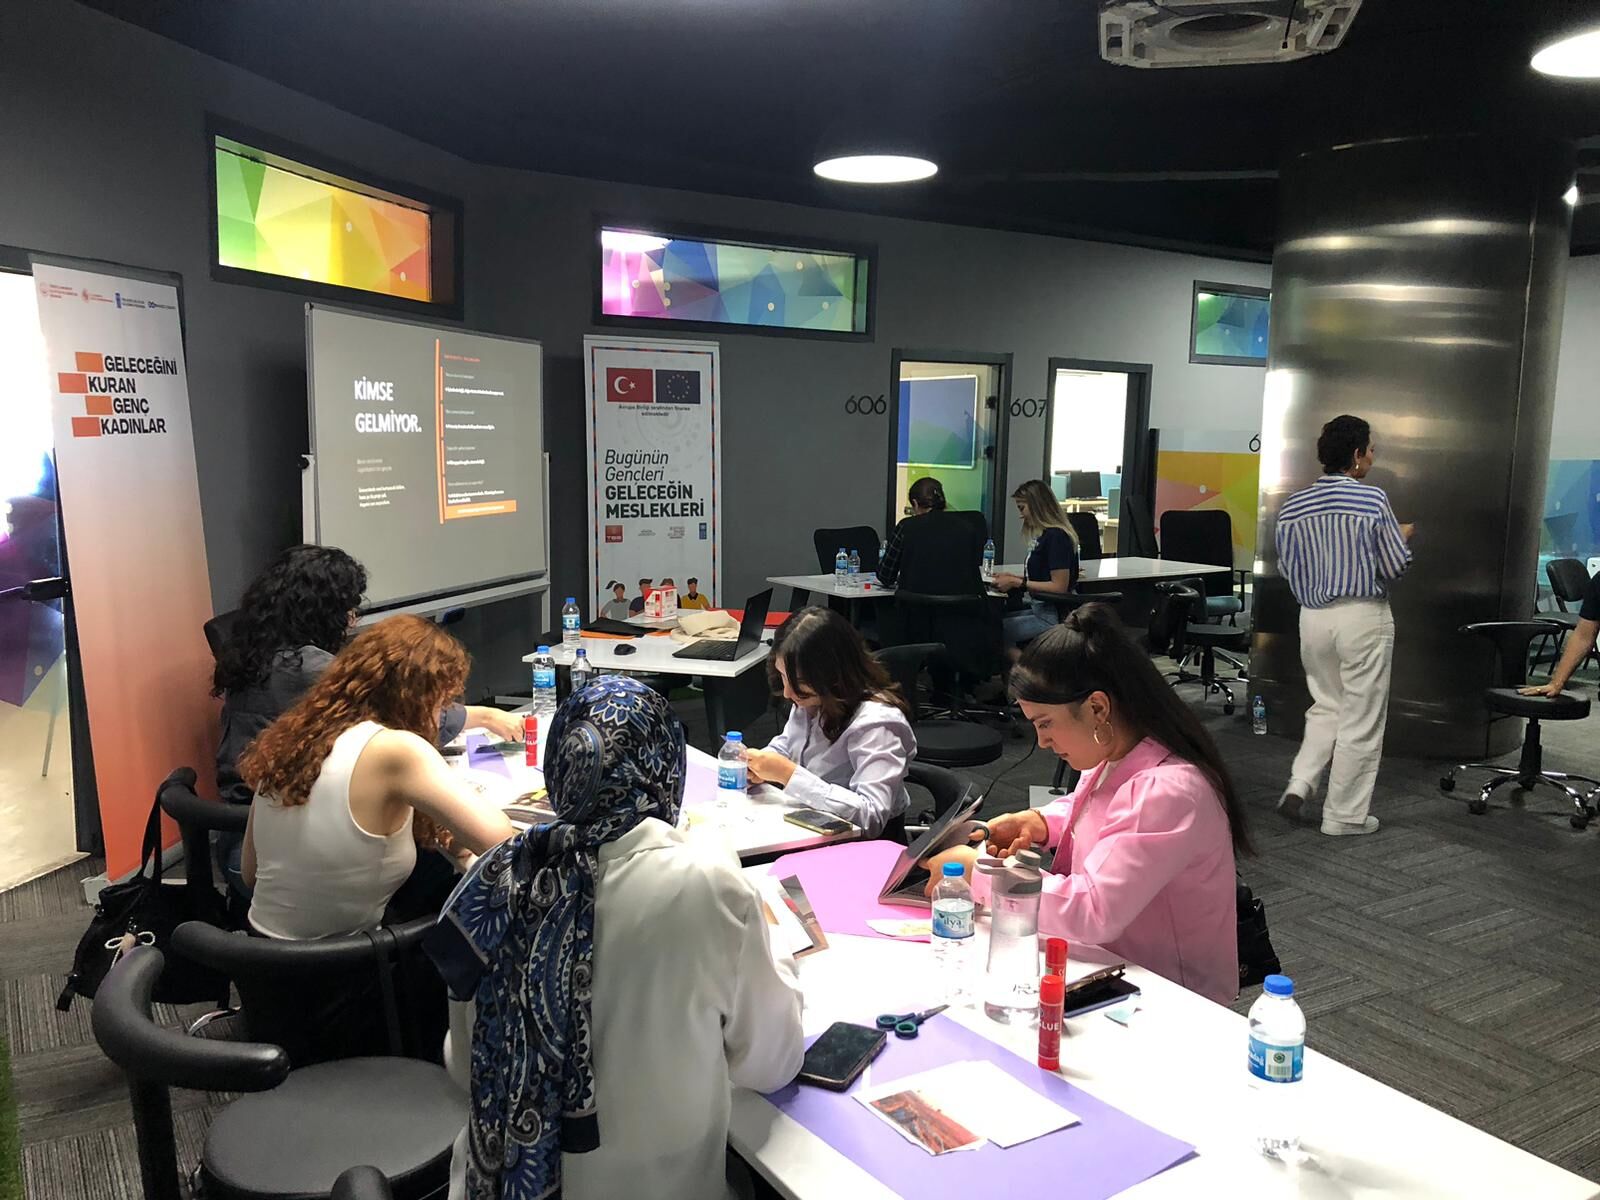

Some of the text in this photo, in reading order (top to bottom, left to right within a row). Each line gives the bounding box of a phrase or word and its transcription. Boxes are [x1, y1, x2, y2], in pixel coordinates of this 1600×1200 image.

[104, 356, 178, 375] GELECEĞİNİ
[88, 376, 136, 394] KURAN
[354, 376, 394, 401] KİMSE
[113, 398, 150, 416] GENÇ
[844, 395, 887, 415] 606
[1010, 398, 1047, 418] 607
[100, 418, 167, 435] KADINLAR
[355, 409, 422, 433] GELMİYOR.
[604, 449, 669, 469] Bugünün
[604, 466, 665, 486] Gençleri
[605, 480, 693, 500] GELECEĞİN
[606, 498, 705, 519] MESLEKLERİ
